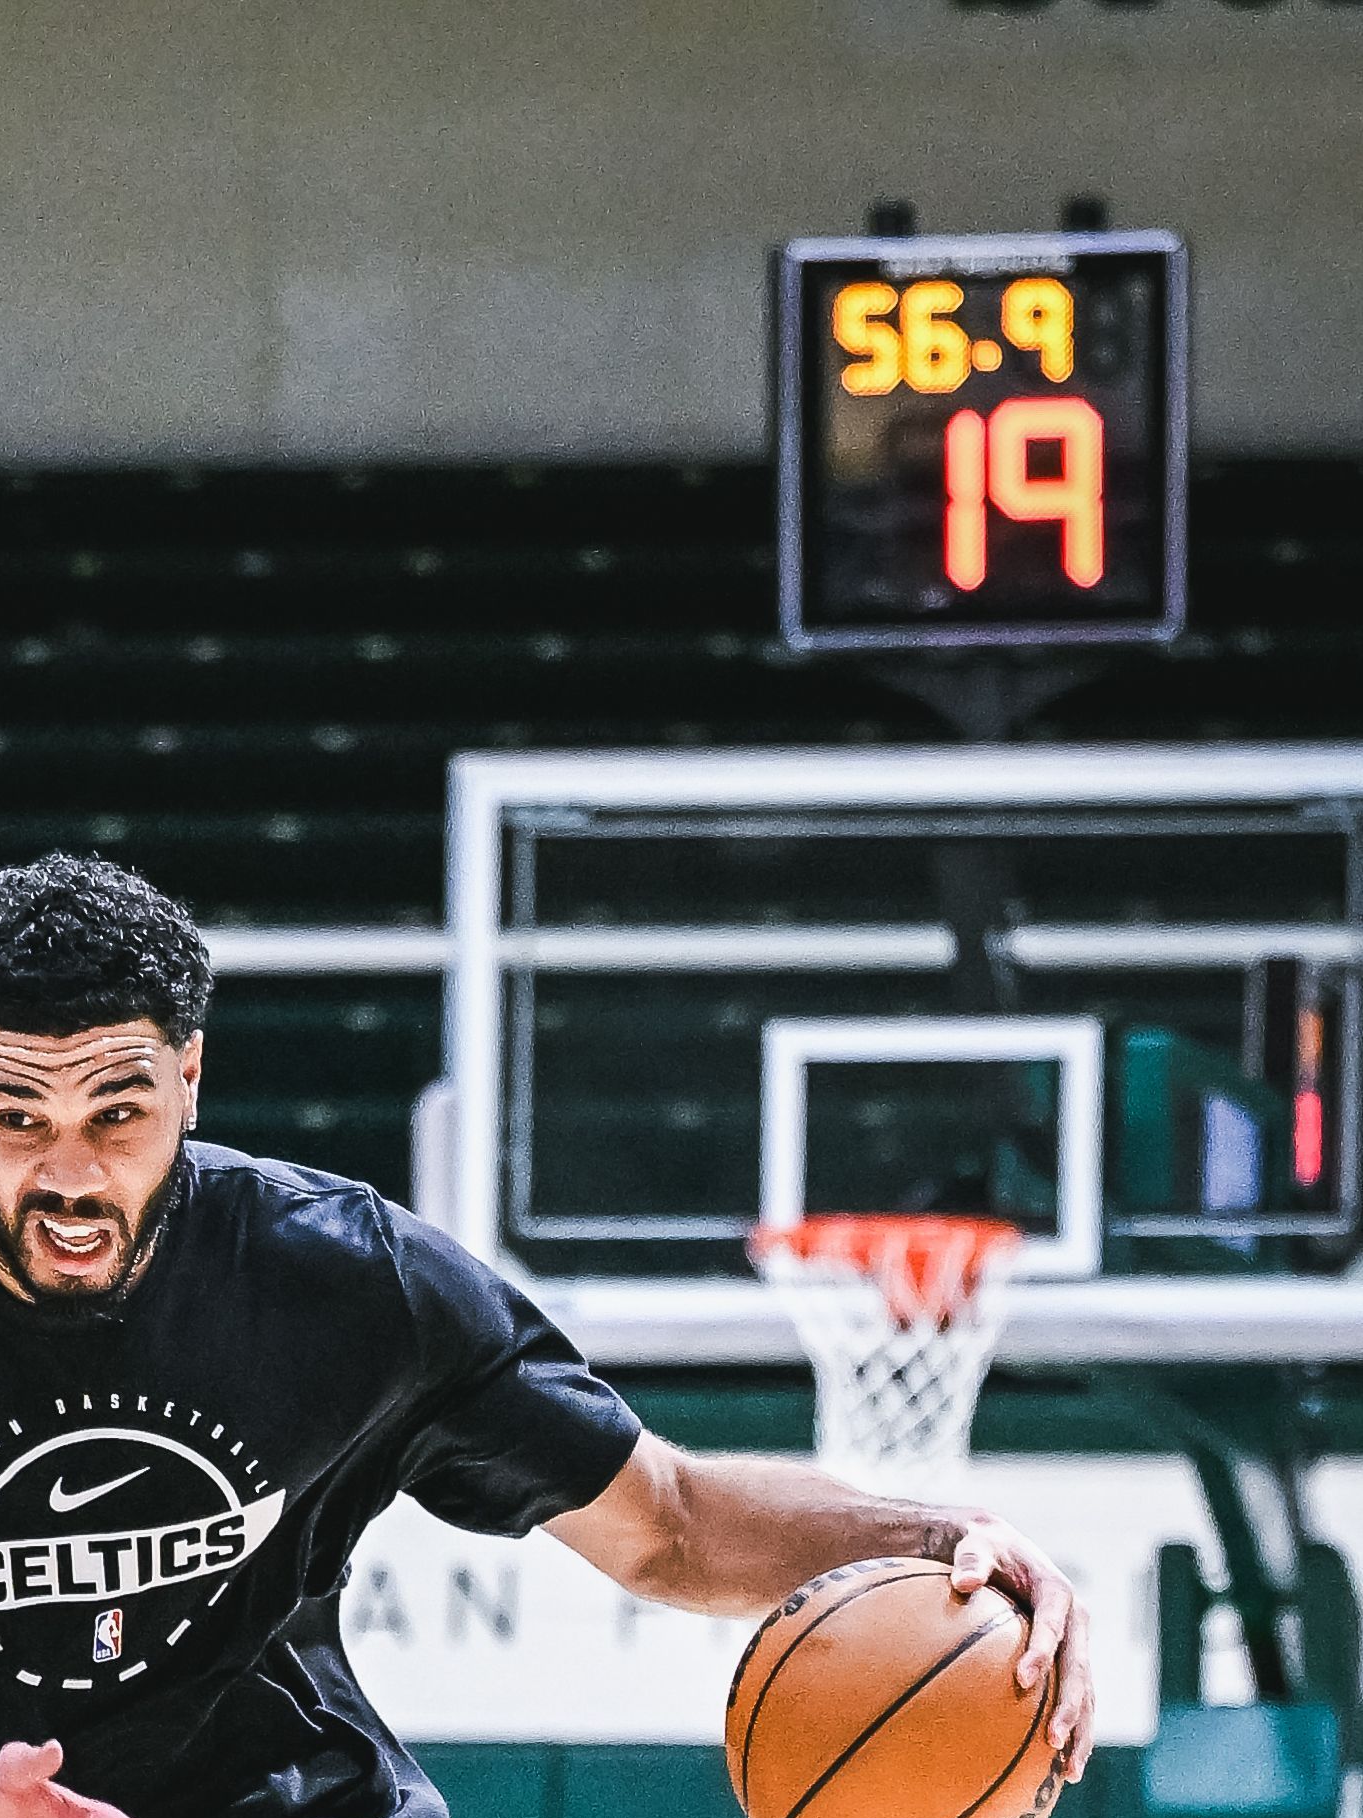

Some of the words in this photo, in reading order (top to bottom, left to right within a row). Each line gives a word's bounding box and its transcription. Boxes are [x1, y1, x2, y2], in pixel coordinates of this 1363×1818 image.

[833, 278, 1074, 395] 56.9
[944, 397, 1104, 590] 19
[55, 1393, 268, 1493] BASKETBALL
